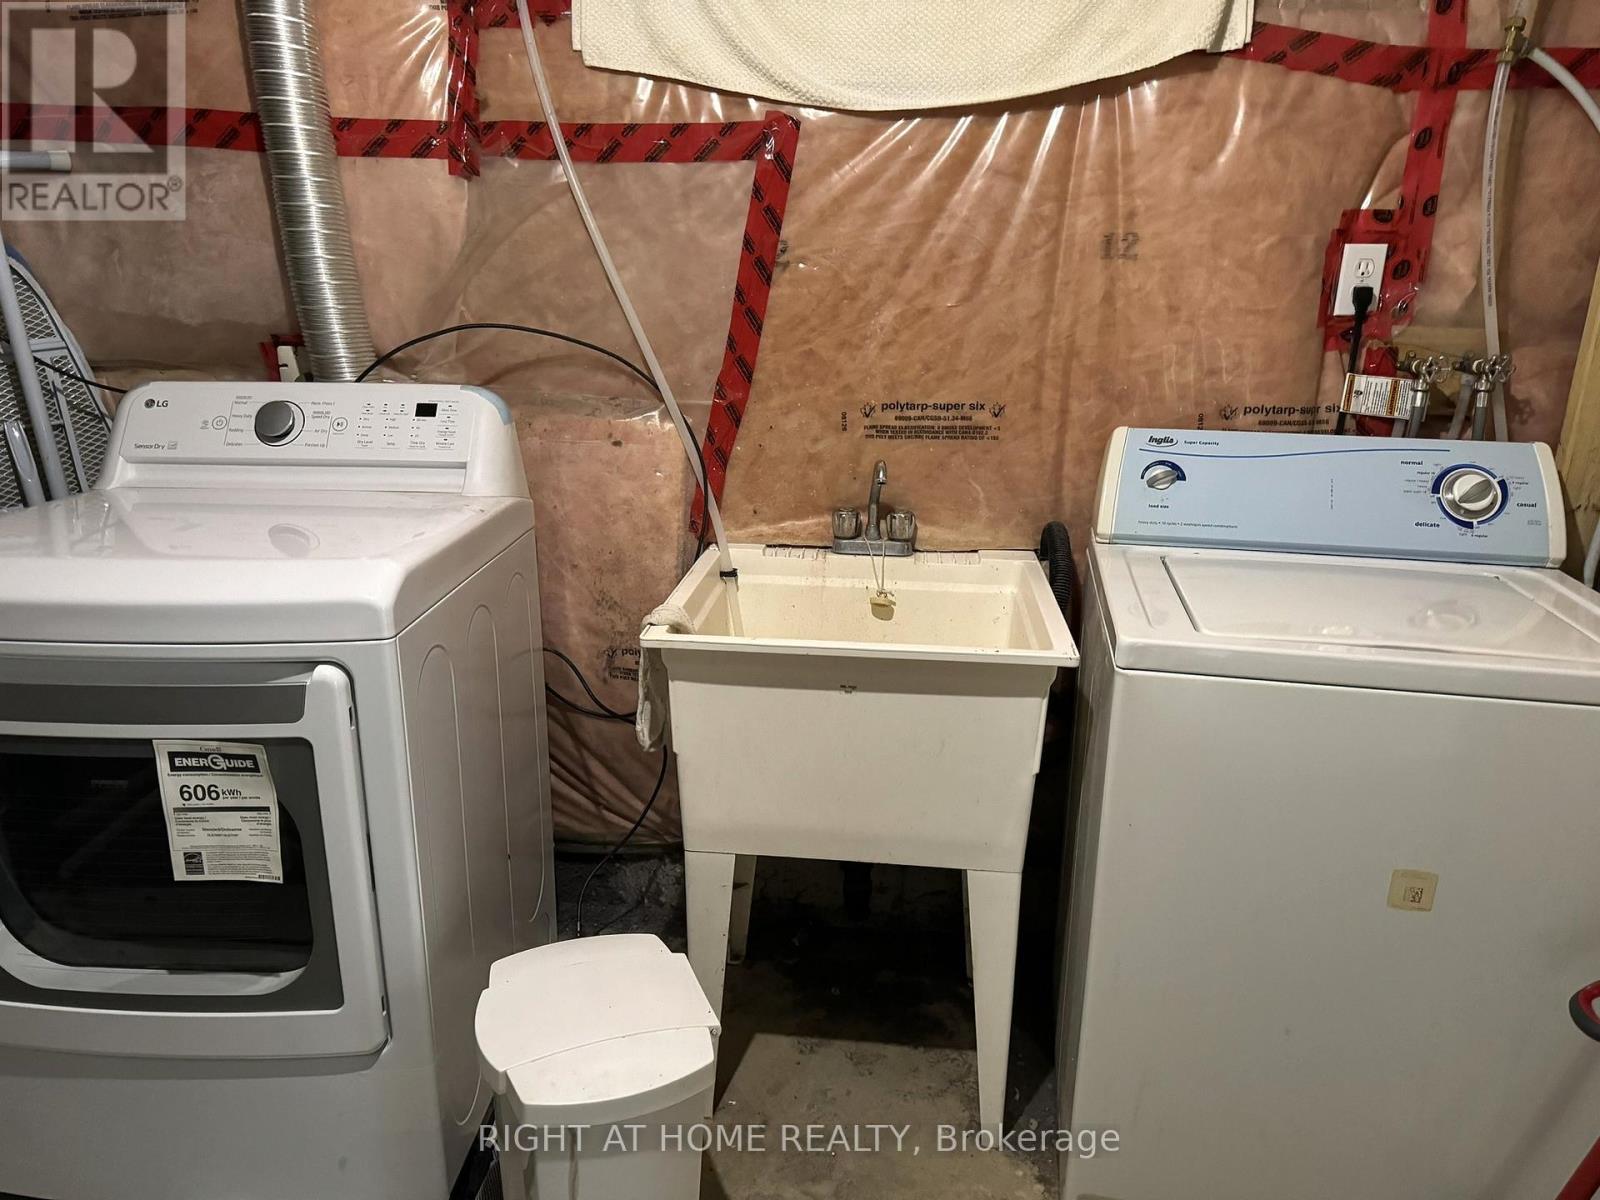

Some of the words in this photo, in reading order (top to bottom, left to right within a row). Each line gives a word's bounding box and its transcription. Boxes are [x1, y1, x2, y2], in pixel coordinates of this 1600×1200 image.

[881, 400, 966, 412] polytarp-super
[968, 401, 986, 411] six
[1148, 435, 1174, 445] Inglis
[174, 754, 255, 771] ENERGUIDE
[179, 784, 220, 802] 606
[222, 788, 242, 796] kWh
